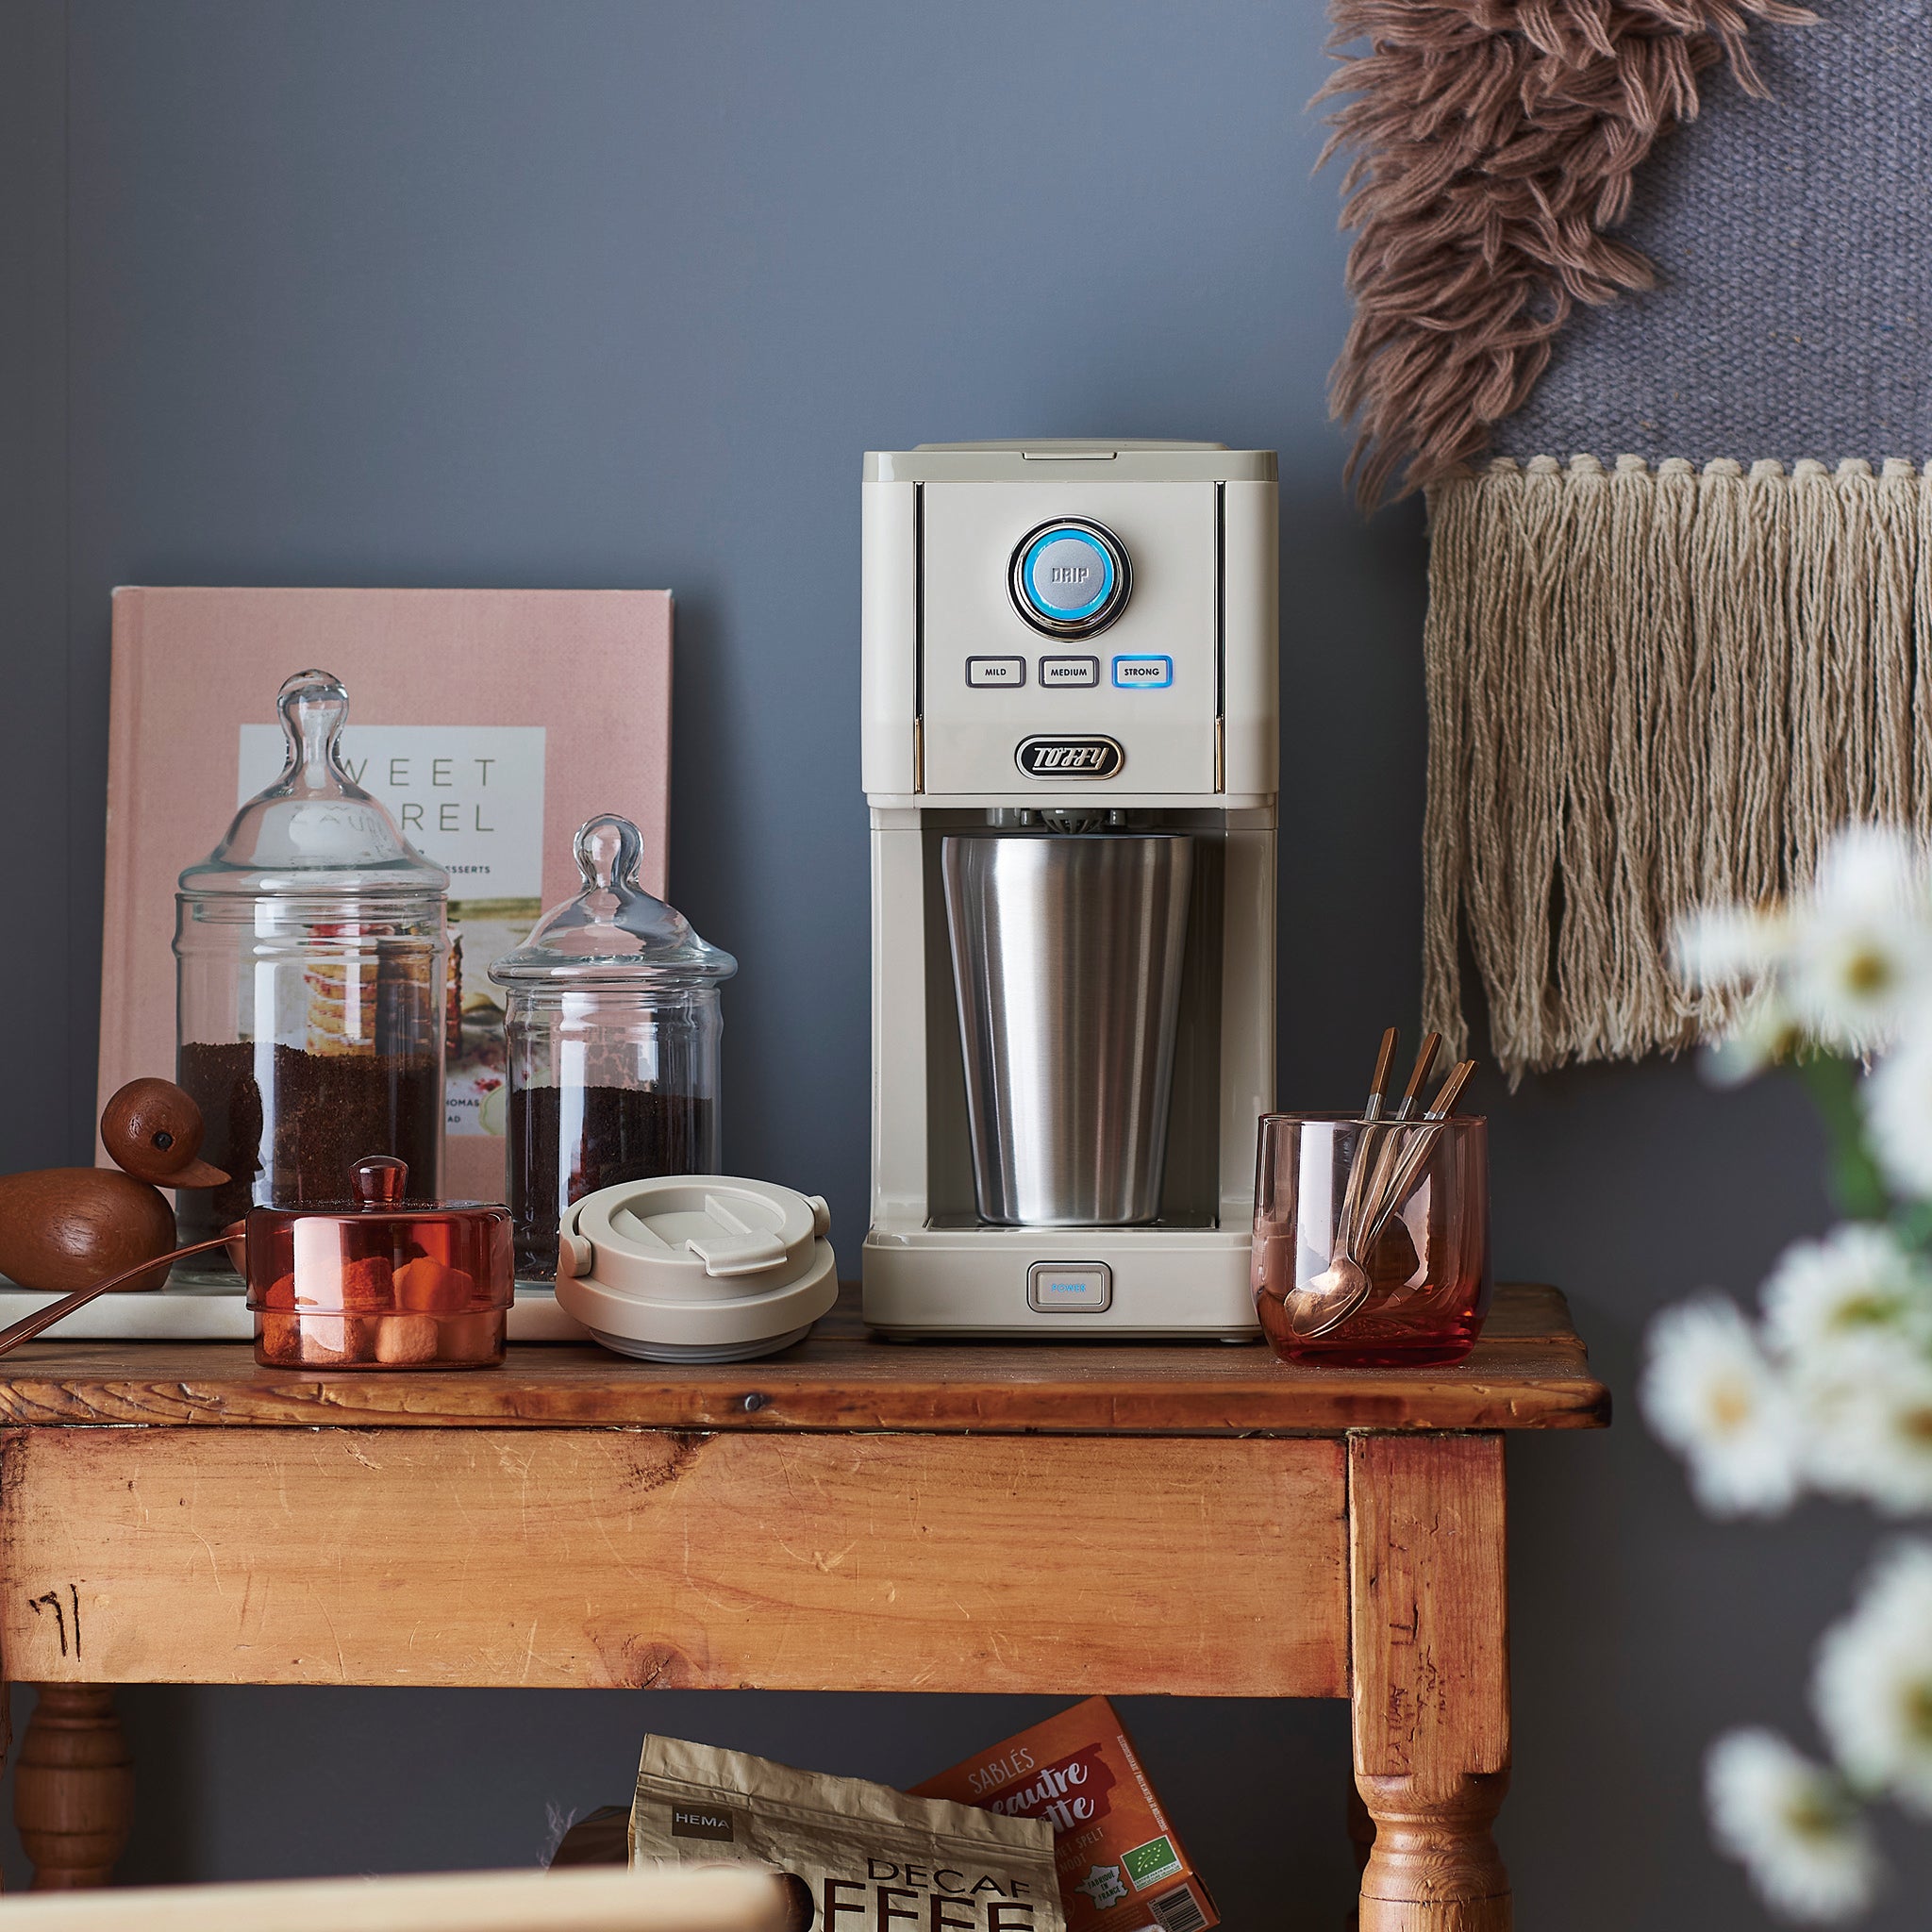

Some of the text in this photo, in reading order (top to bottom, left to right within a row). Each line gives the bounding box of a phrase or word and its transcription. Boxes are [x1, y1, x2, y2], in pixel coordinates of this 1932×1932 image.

[1051, 567, 1090, 584] DRIP
[984, 667, 1008, 677] MILD
[1050, 667, 1088, 677] MEDIUM
[1124, 667, 1160, 677] STRONG
[342, 758, 495, 787] WEET
[401, 803, 495, 832] REL
[444, 865, 491, 874] ESSERTS
[445, 1099, 480, 1108] HOMAS
[1051, 1283, 1087, 1293] POWER
[968, 1747, 1035, 1793] SABLÉS
[991, 1762, 1088, 1817] eautre
[675, 1812, 731, 1829] HEMA
[1041, 1796, 1095, 1833] tte
[1075, 1826, 1105, 1849] SPELT
[1058, 1853, 1087, 1875] NOOT
[867, 1857, 1031, 1898] DECAF
[1100, 1881, 1109, 1891] EN
[1098, 1885, 1122, 1902] FRANCE
[824, 1877, 1035, 1932] FFEE
